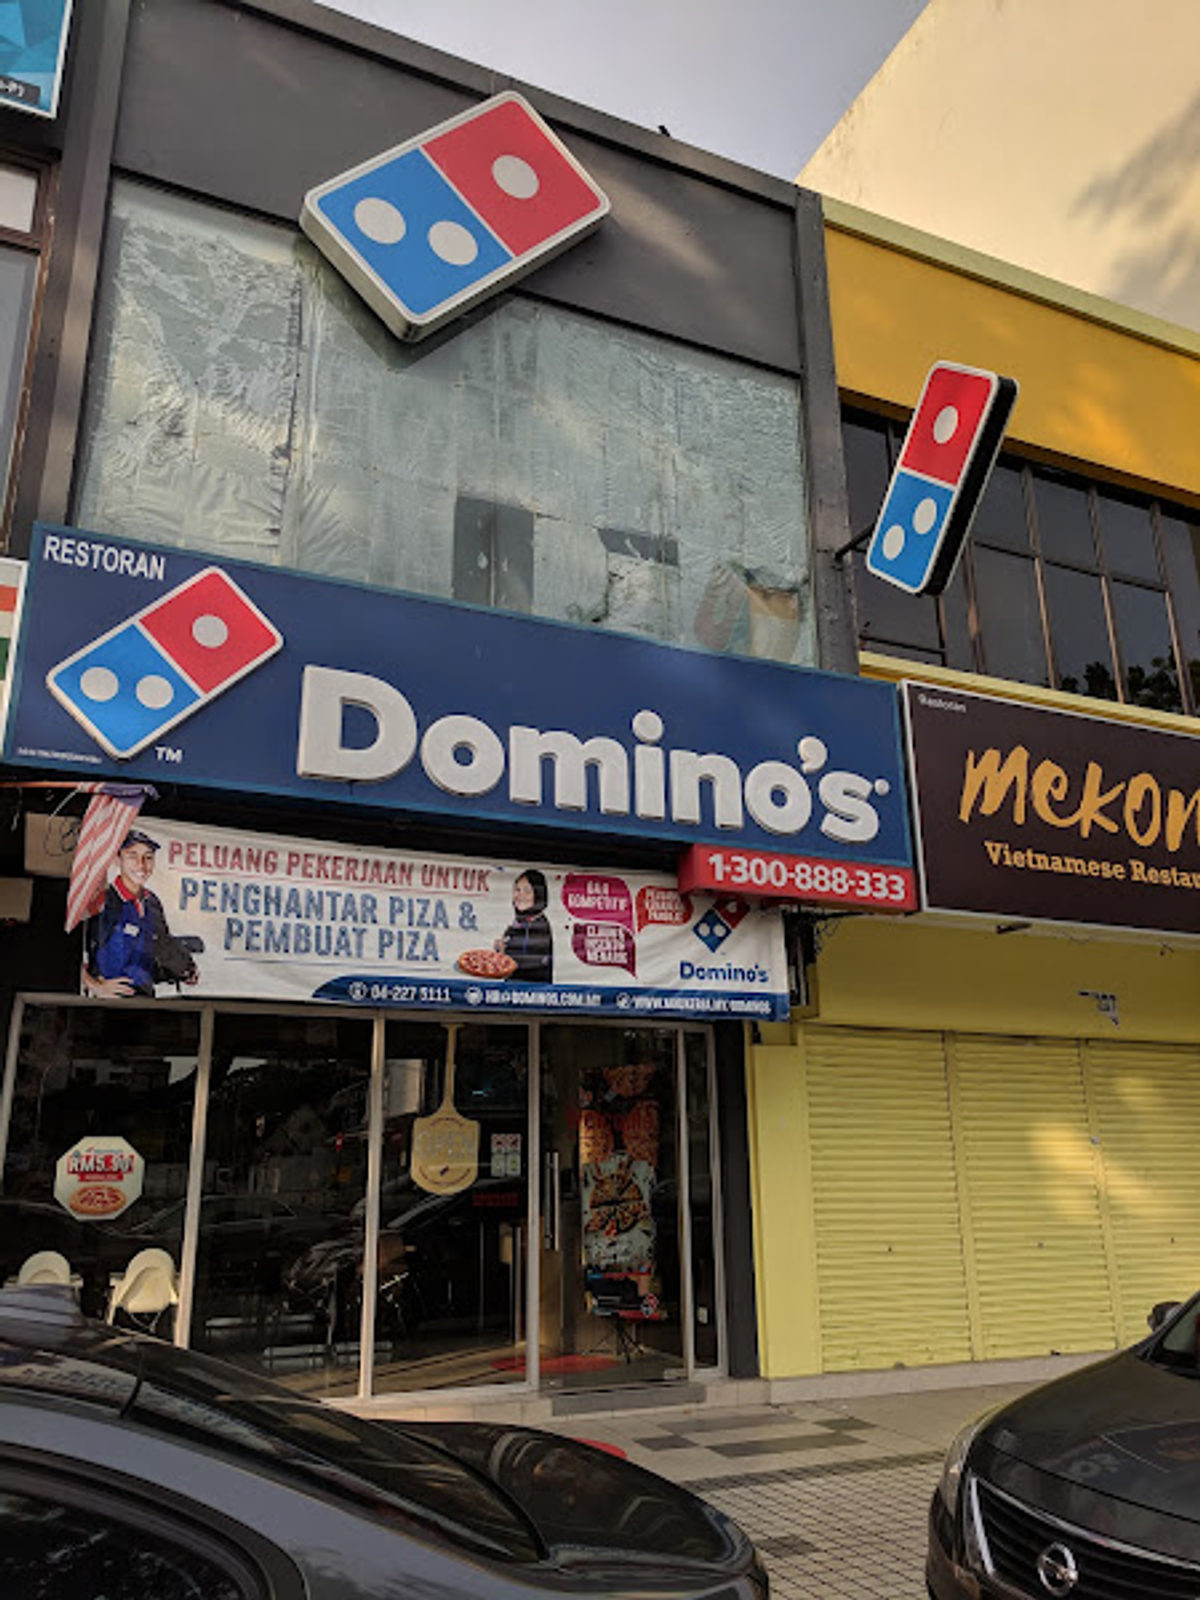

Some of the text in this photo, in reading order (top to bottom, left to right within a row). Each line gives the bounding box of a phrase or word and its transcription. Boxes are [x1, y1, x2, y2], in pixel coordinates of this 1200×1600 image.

[43, 535, 166, 581] RESTORAN
[155, 746, 183, 763] TM
[297, 664, 879, 844] Domino's
[168, 840, 493, 892] PELUANG PEKERJAAN UNTUK
[709, 852, 906, 901] 1-300-888-333
[984, 840, 1125, 880] Vietnamese
[178, 877, 479, 931] PENGHANTAR PIZA &
[223, 916, 440, 962] PEMBUAT PIZA
[680, 960, 769, 983] Domino's
